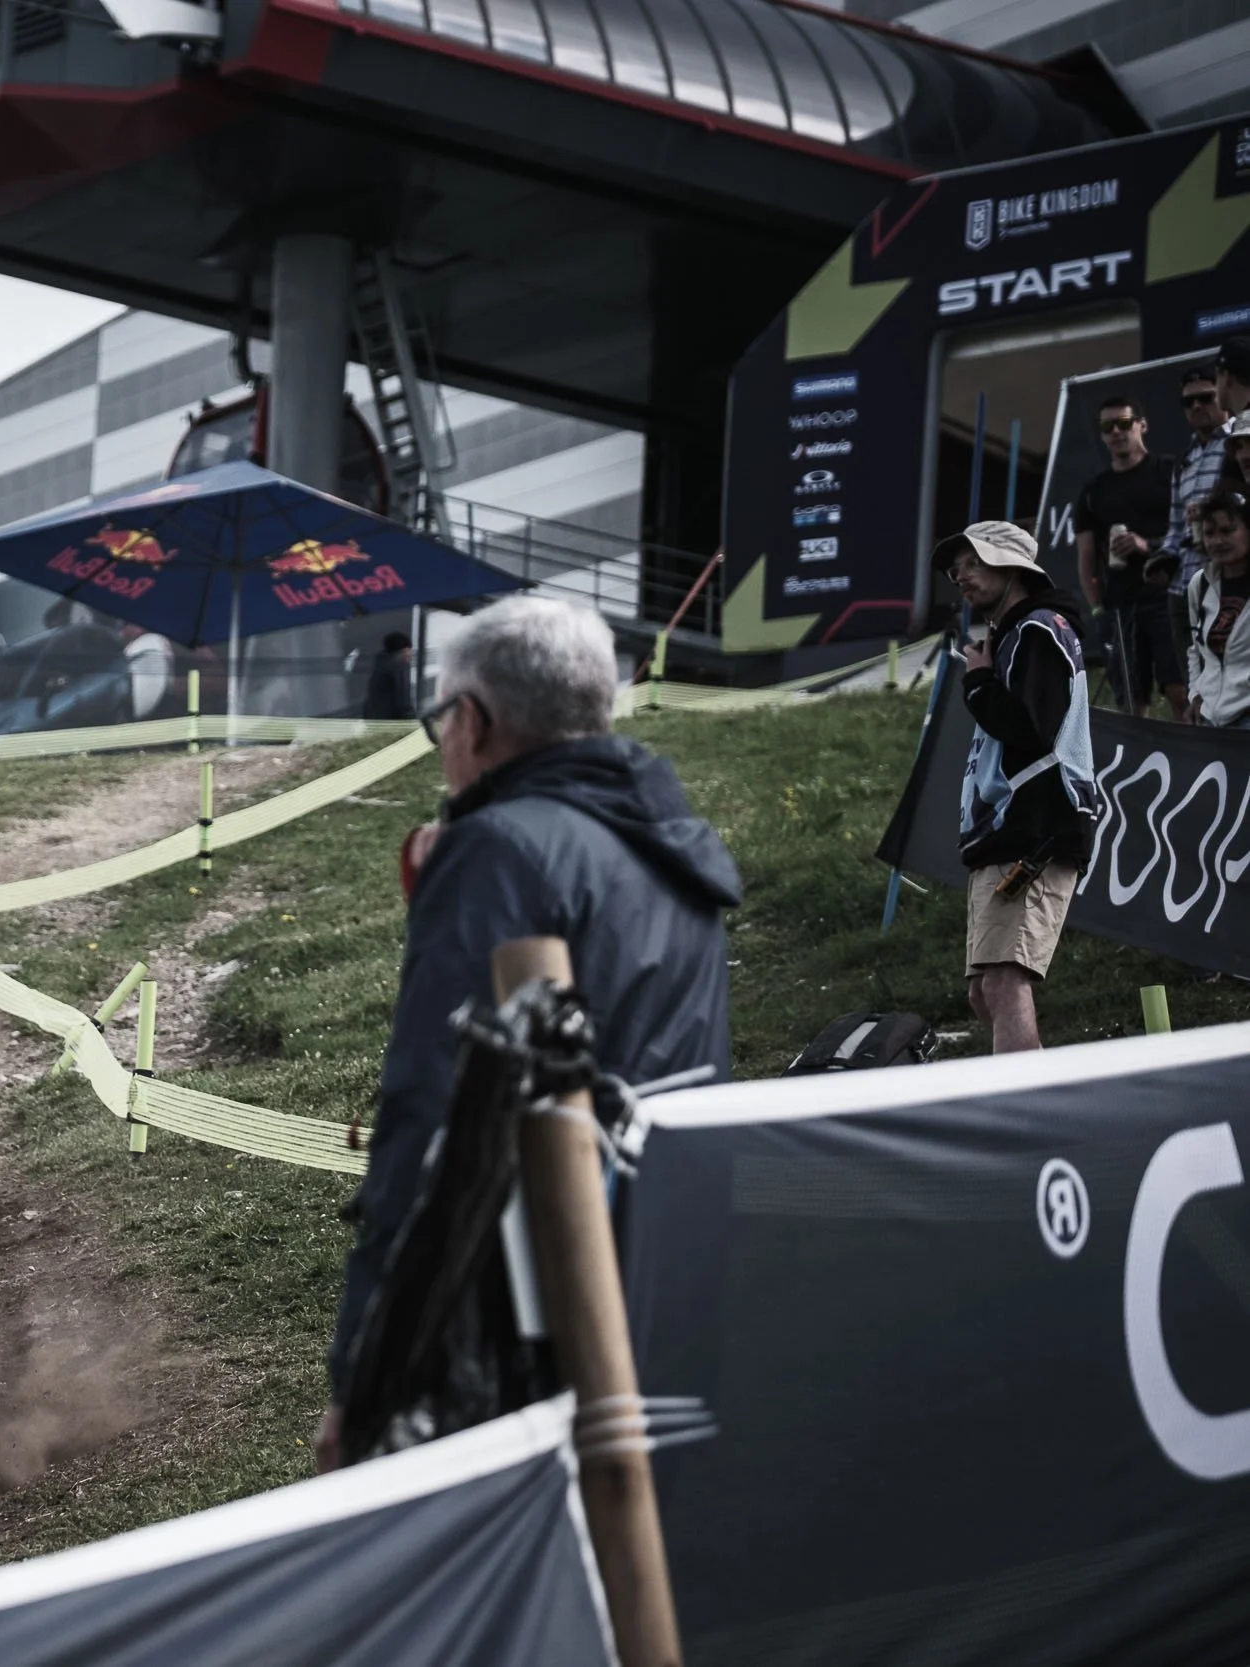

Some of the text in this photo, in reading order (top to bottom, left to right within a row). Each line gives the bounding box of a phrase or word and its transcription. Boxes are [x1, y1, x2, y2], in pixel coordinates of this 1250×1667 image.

[998, 195, 1036, 223] BIKE
[1040, 178, 1119, 216] KINGDOM
[938, 250, 1132, 316] START
[789, 409, 857, 429] WHOOP
